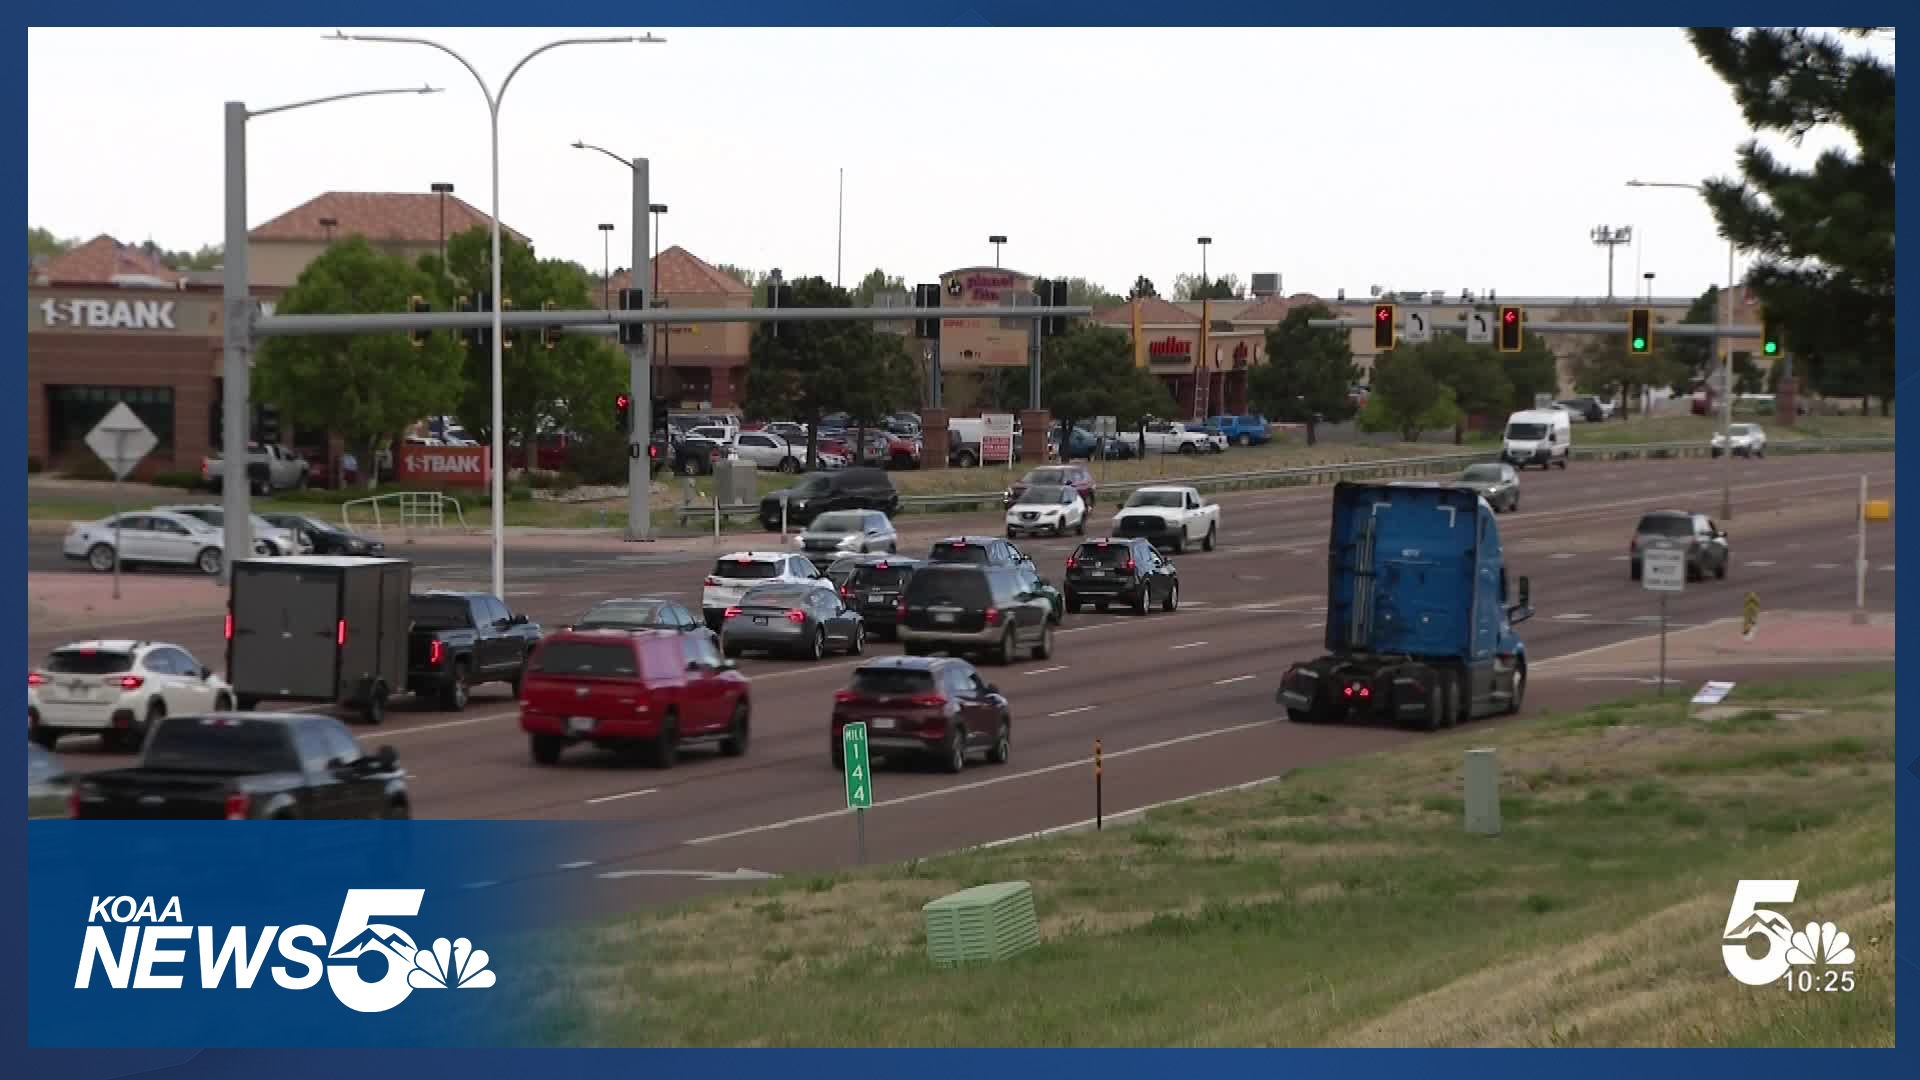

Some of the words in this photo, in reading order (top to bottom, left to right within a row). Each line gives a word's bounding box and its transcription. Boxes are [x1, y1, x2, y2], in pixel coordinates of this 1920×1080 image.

[40, 298, 176, 330] 1STBANK
[404, 453, 481, 474] 1STBANK
[845, 727, 864, 742] MILE
